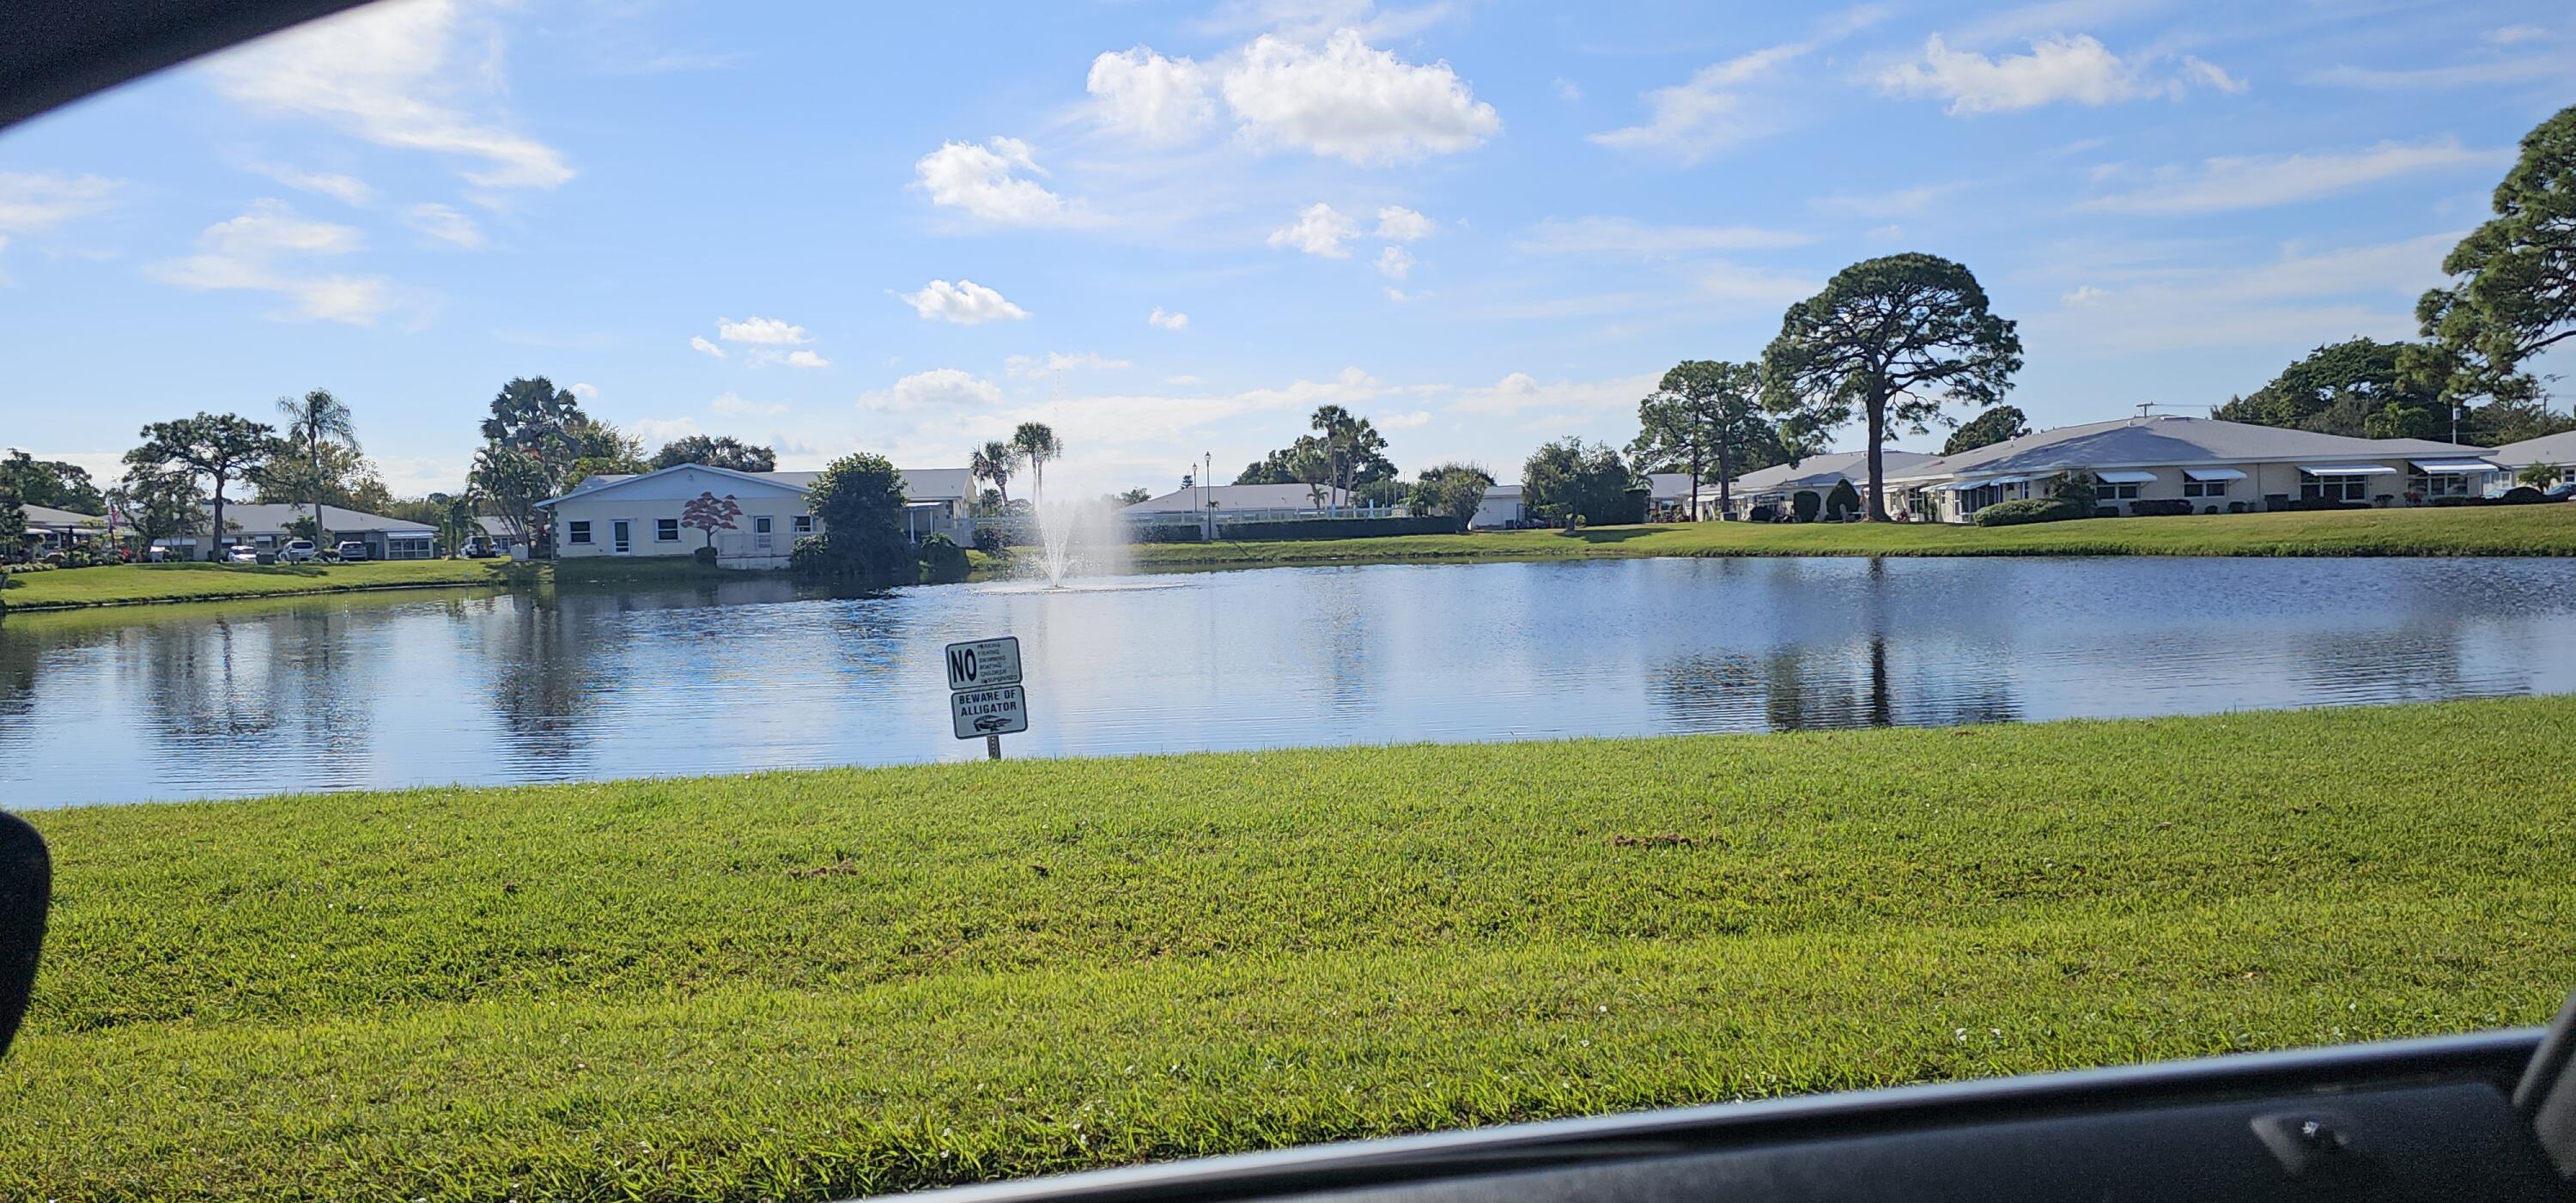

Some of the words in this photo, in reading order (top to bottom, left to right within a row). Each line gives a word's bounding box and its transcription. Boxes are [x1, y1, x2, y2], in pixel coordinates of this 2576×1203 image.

[950, 648, 977, 683] NO
[959, 691, 999, 704] BEWARE
[1004, 690, 1016, 699] OF
[961, 702, 1017, 717] ALLIGATOR
